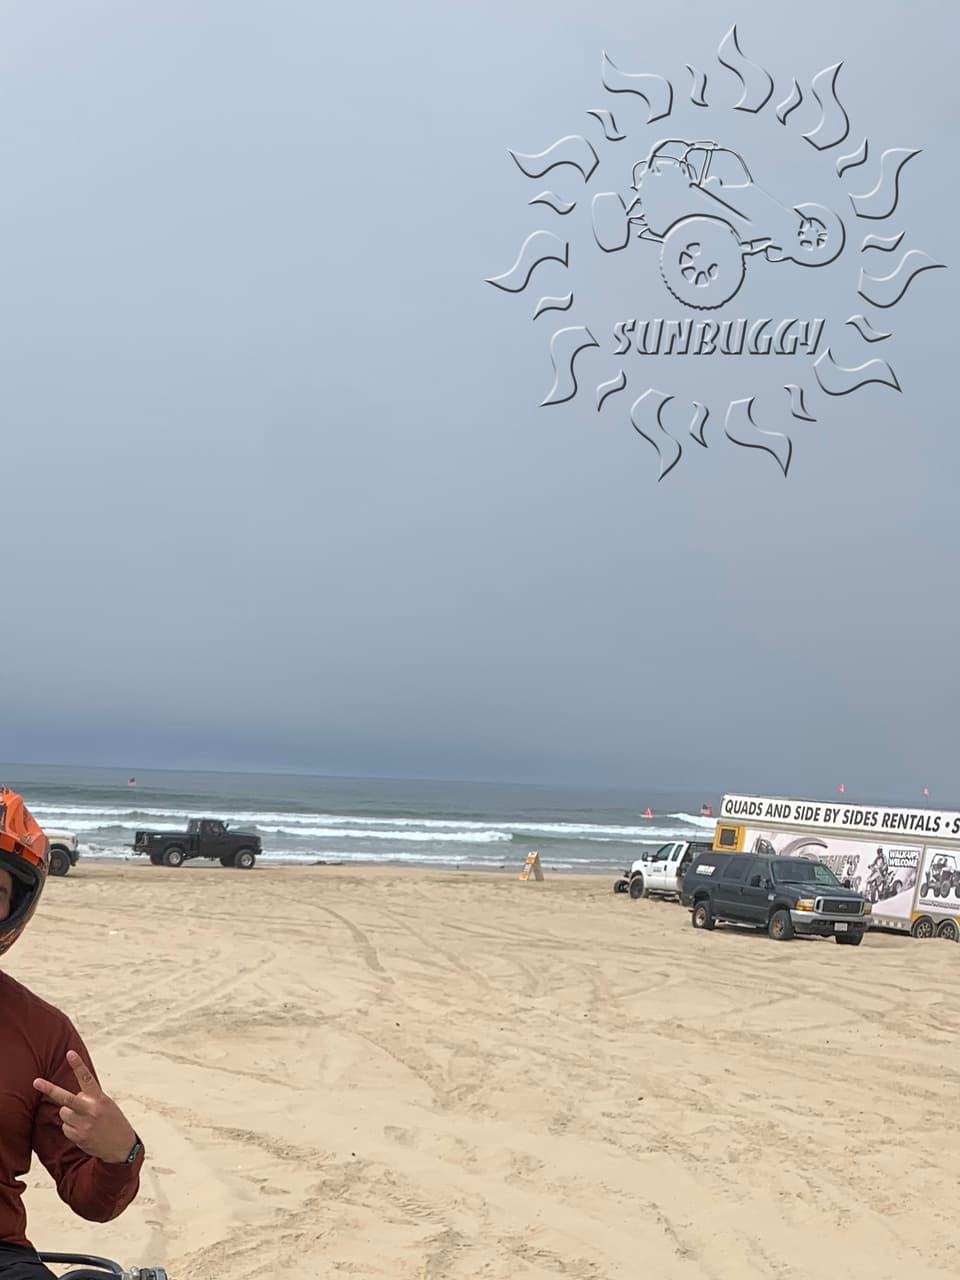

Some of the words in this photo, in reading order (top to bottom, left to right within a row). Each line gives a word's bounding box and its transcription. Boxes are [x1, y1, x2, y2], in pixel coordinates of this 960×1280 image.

[725, 799, 763, 816] QUADS
[765, 803, 791, 819] AND
[794, 806, 821, 821] SIDE
[824, 808, 840, 823] BY
[842, 809, 878, 827] SIDES
[881, 812, 941, 833] RENTALS
